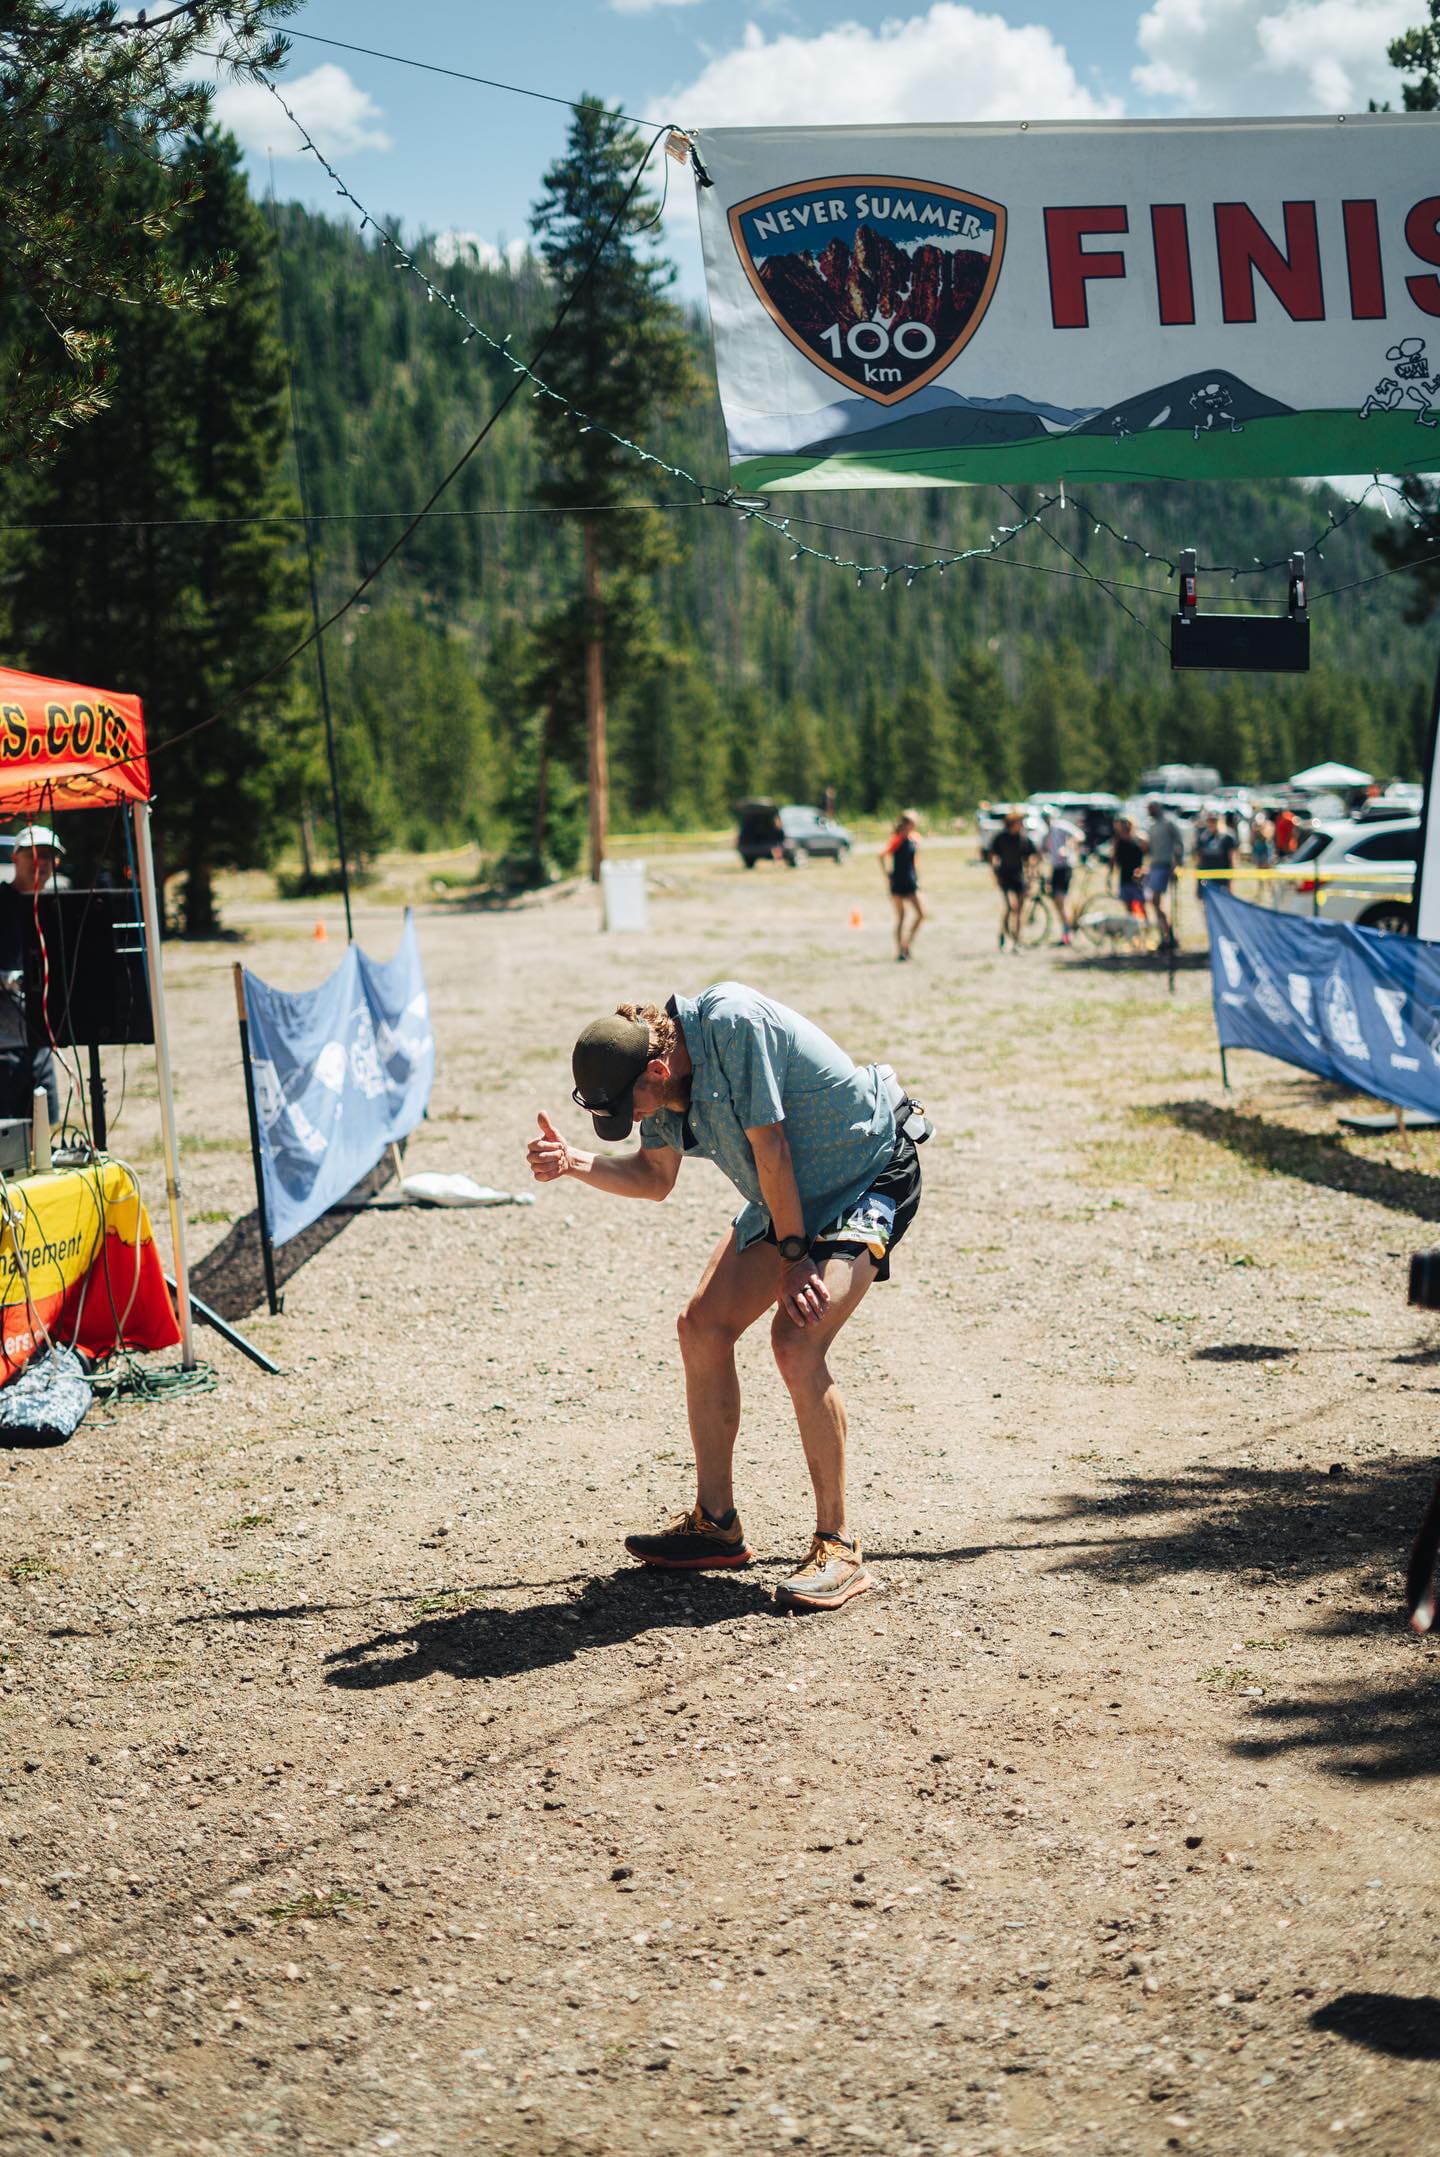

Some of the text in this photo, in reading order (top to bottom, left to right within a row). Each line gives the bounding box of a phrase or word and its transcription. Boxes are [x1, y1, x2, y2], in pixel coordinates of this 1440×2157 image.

[752, 193, 982, 241] NEVER SUMMER
[818, 321, 937, 360] 100
[863, 363, 902, 382] km
